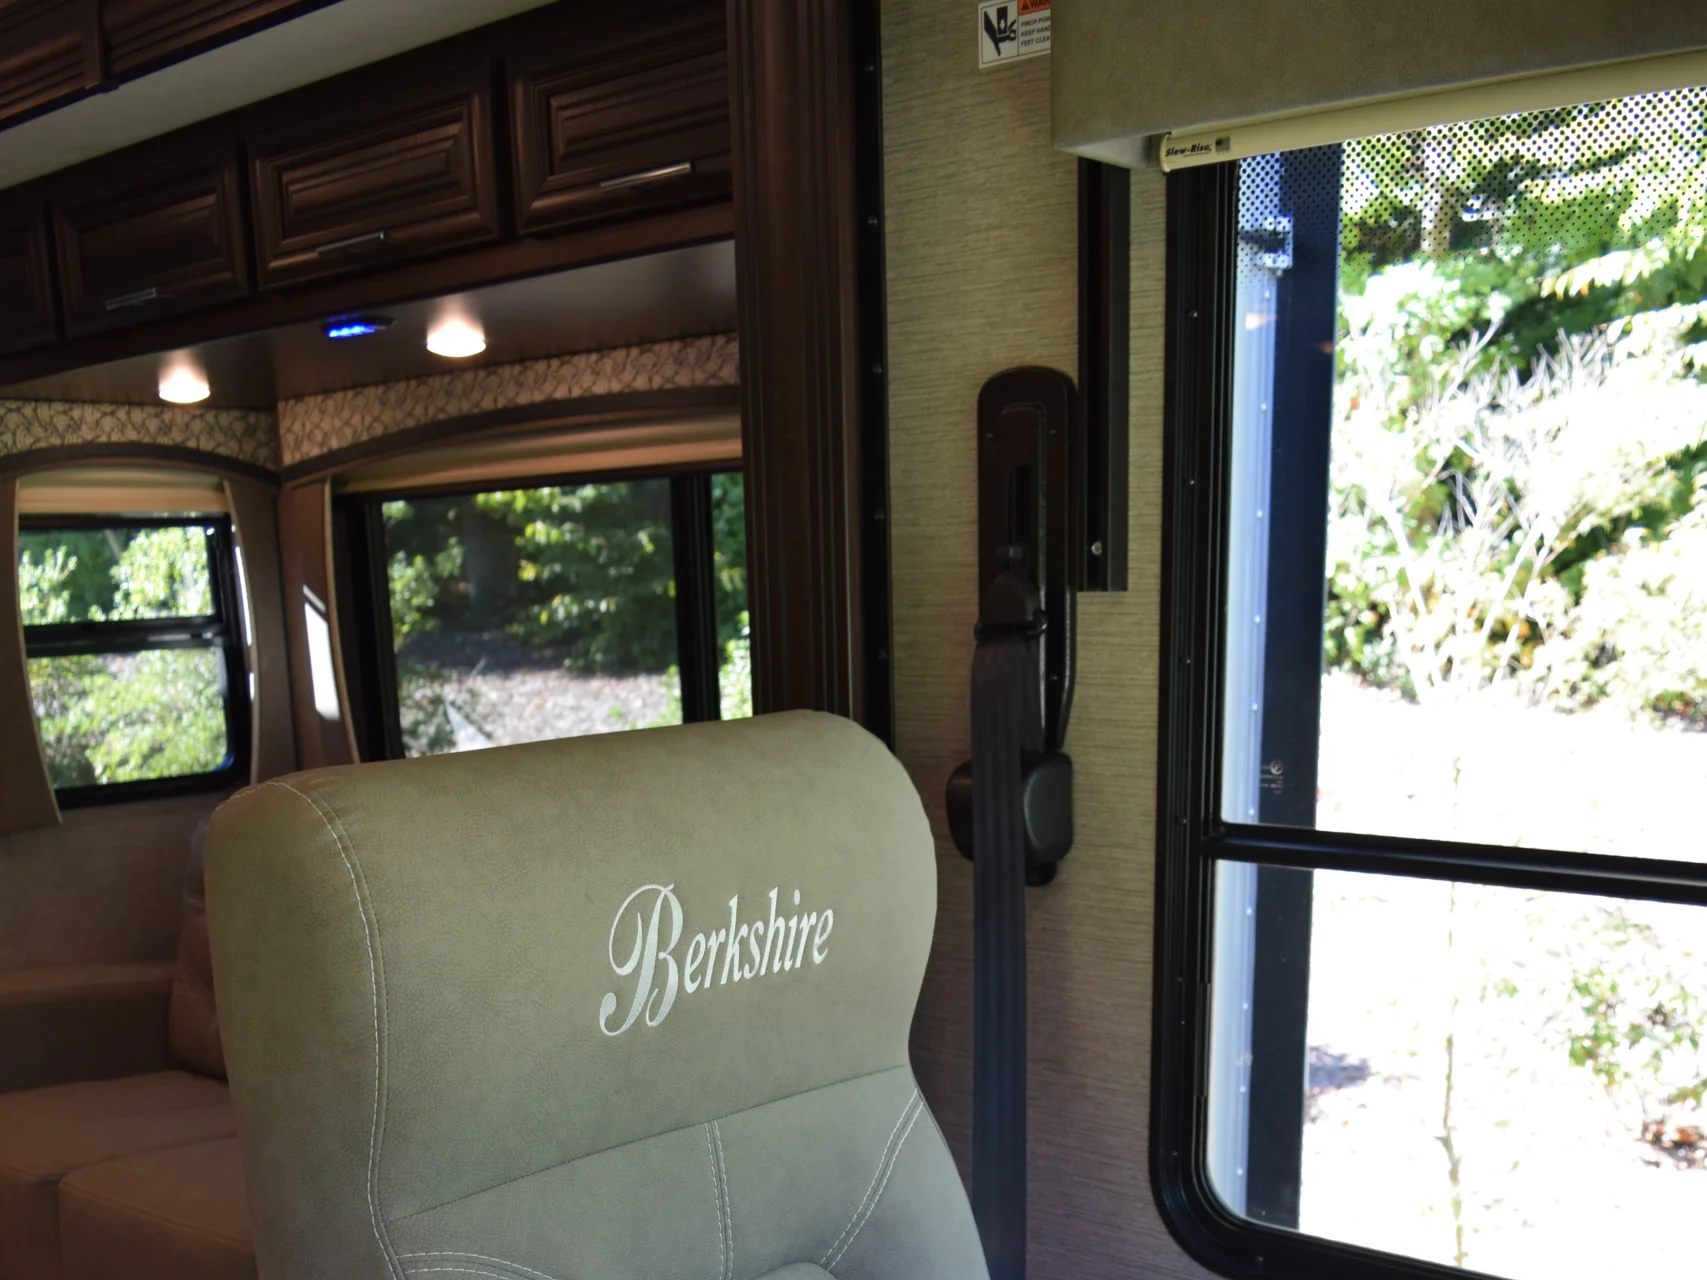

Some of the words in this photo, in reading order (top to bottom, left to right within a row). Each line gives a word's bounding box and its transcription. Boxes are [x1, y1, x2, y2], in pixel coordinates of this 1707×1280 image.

[1021, 19, 1037, 27] PINCH
[1021, 28, 1036, 36] KEEP
[1021, 38, 1034, 47] FEET
[1166, 143, 1211, 157] Slow-Rise
[599, 883, 834, 1036] Berkshire
